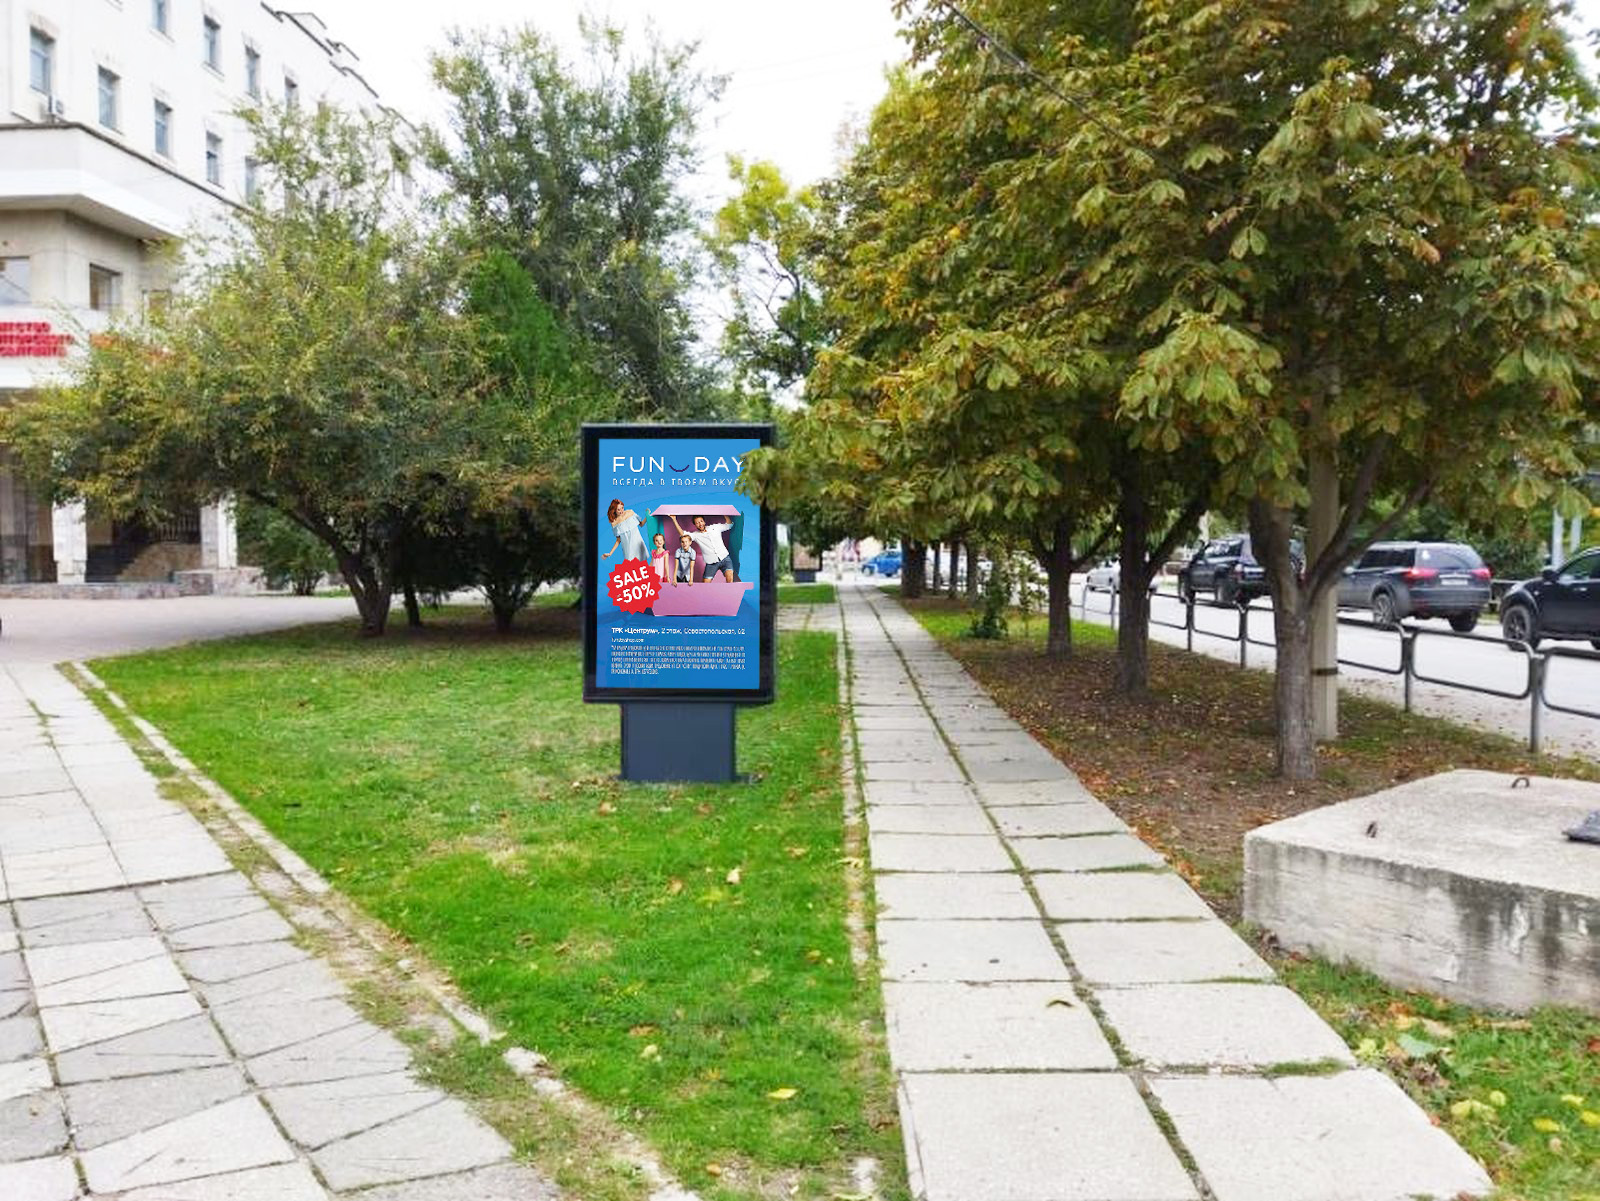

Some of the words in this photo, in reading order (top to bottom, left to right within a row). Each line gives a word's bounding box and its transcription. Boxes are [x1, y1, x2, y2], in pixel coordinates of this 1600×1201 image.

[613, 456, 665, 473] FUN
[694, 456, 744, 473] DAY
[613, 478, 654, 487] ВСЕГДА
[660, 478, 666, 486] В
[671, 478, 707, 486] ТВОЕМ
[613, 566, 649, 588] SALE
[616, 582, 655, 603] -50%
